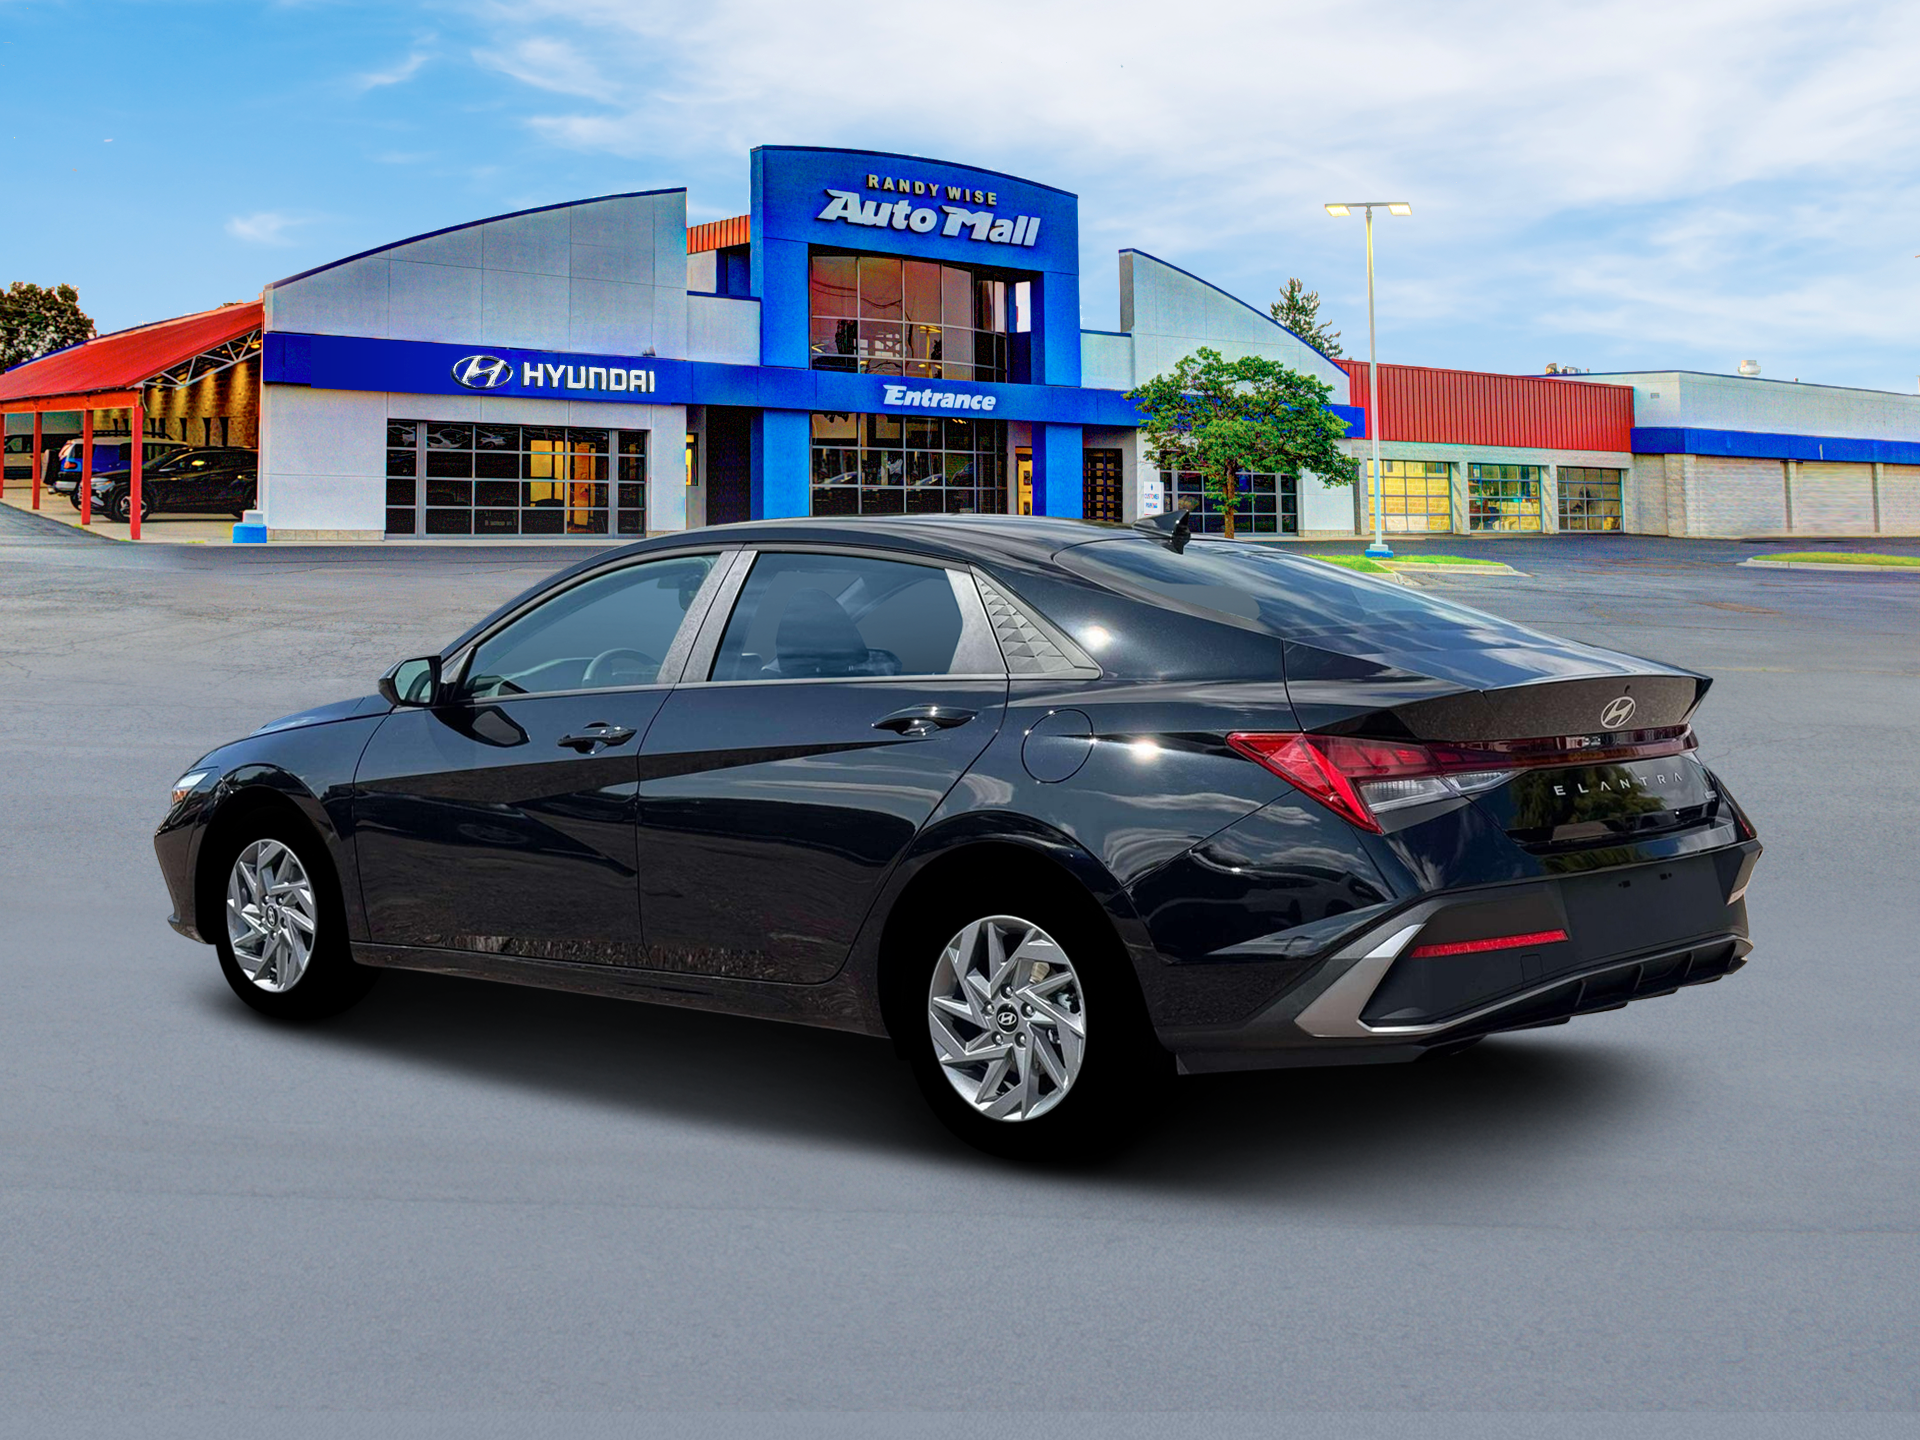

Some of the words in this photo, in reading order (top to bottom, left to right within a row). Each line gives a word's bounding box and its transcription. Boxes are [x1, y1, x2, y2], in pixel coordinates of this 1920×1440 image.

[867, 173, 940, 197] RANDY
[945, 185, 998, 206] WISE
[816, 188, 938, 234] Auto
[940, 204, 1042, 247] Mall
[521, 361, 656, 393] HYUNDAI
[882, 384, 997, 411] Entrance
[1553, 772, 1683, 796] ELANTRA
